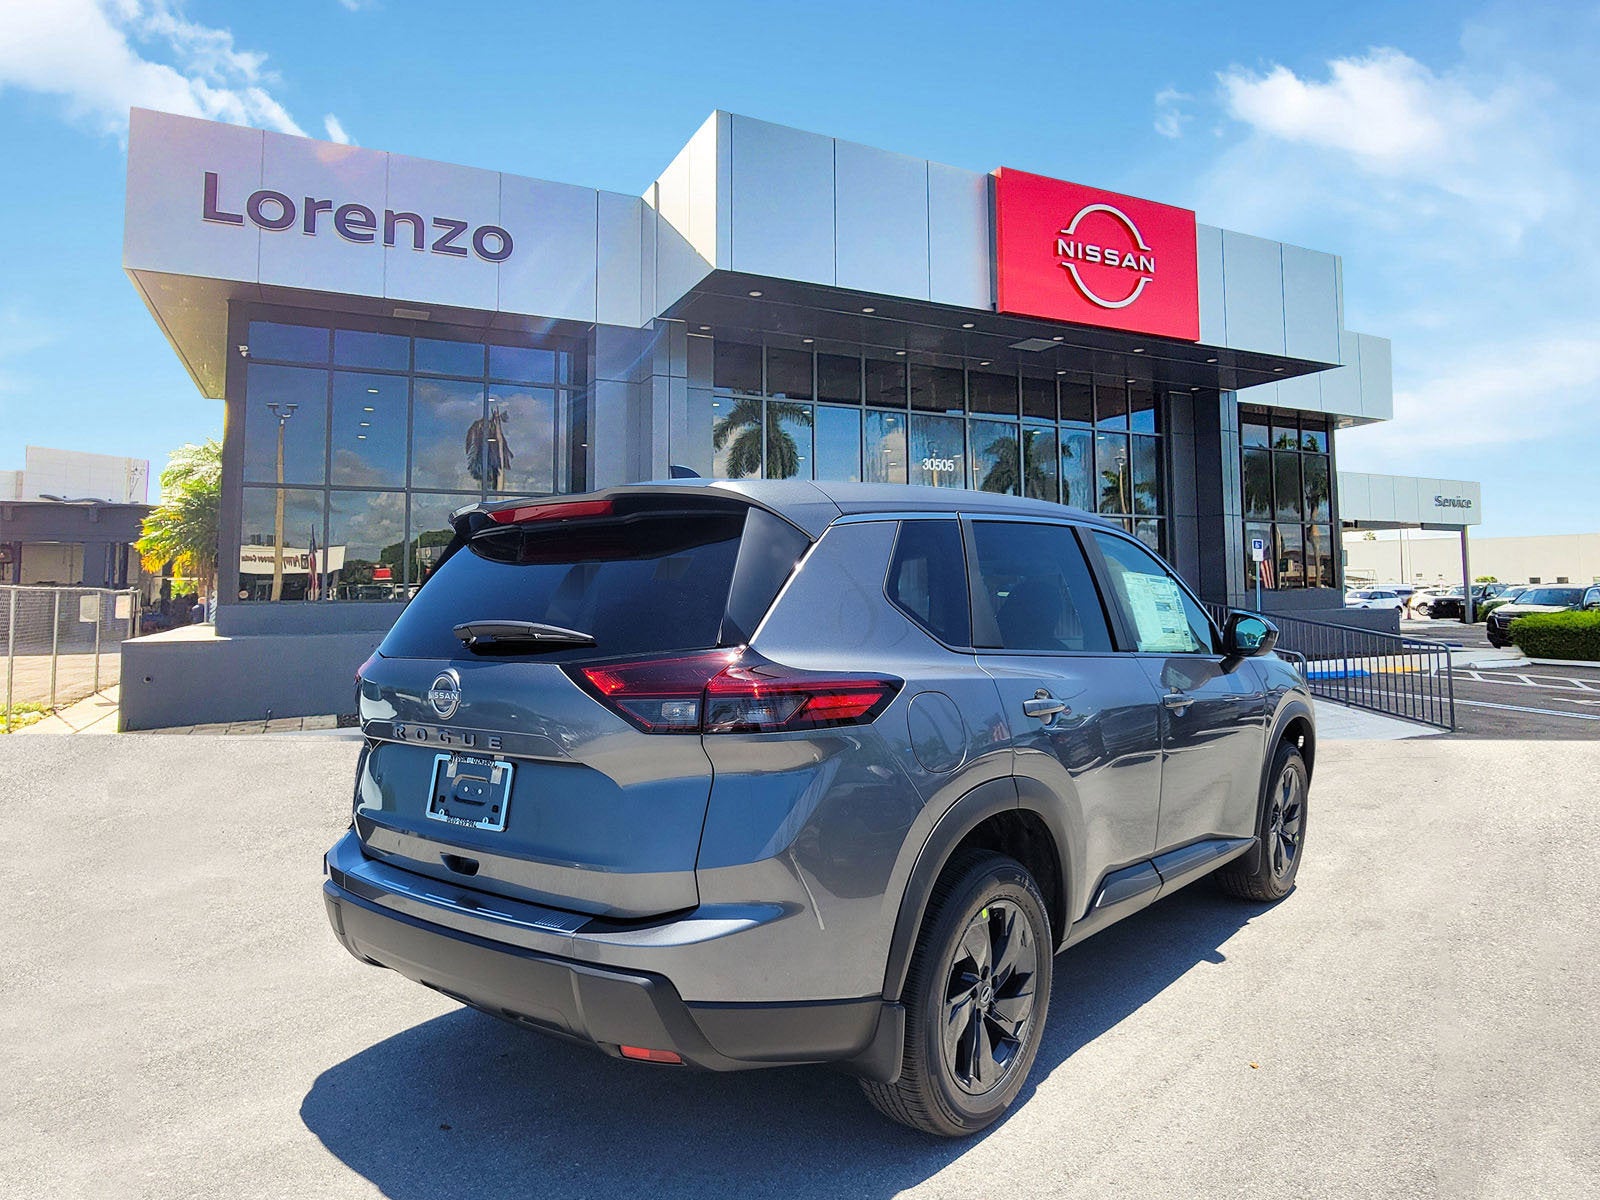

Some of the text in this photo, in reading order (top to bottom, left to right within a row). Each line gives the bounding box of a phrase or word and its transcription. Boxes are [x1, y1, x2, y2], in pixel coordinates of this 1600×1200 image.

[202, 171, 514, 262] Lorenzo
[1056, 238, 1155, 273] NISSAN
[922, 457, 955, 472] 30505
[1434, 495, 1472, 509] Service
[429, 690, 458, 701] SSAN
[393, 723, 503, 750] ROGUE
